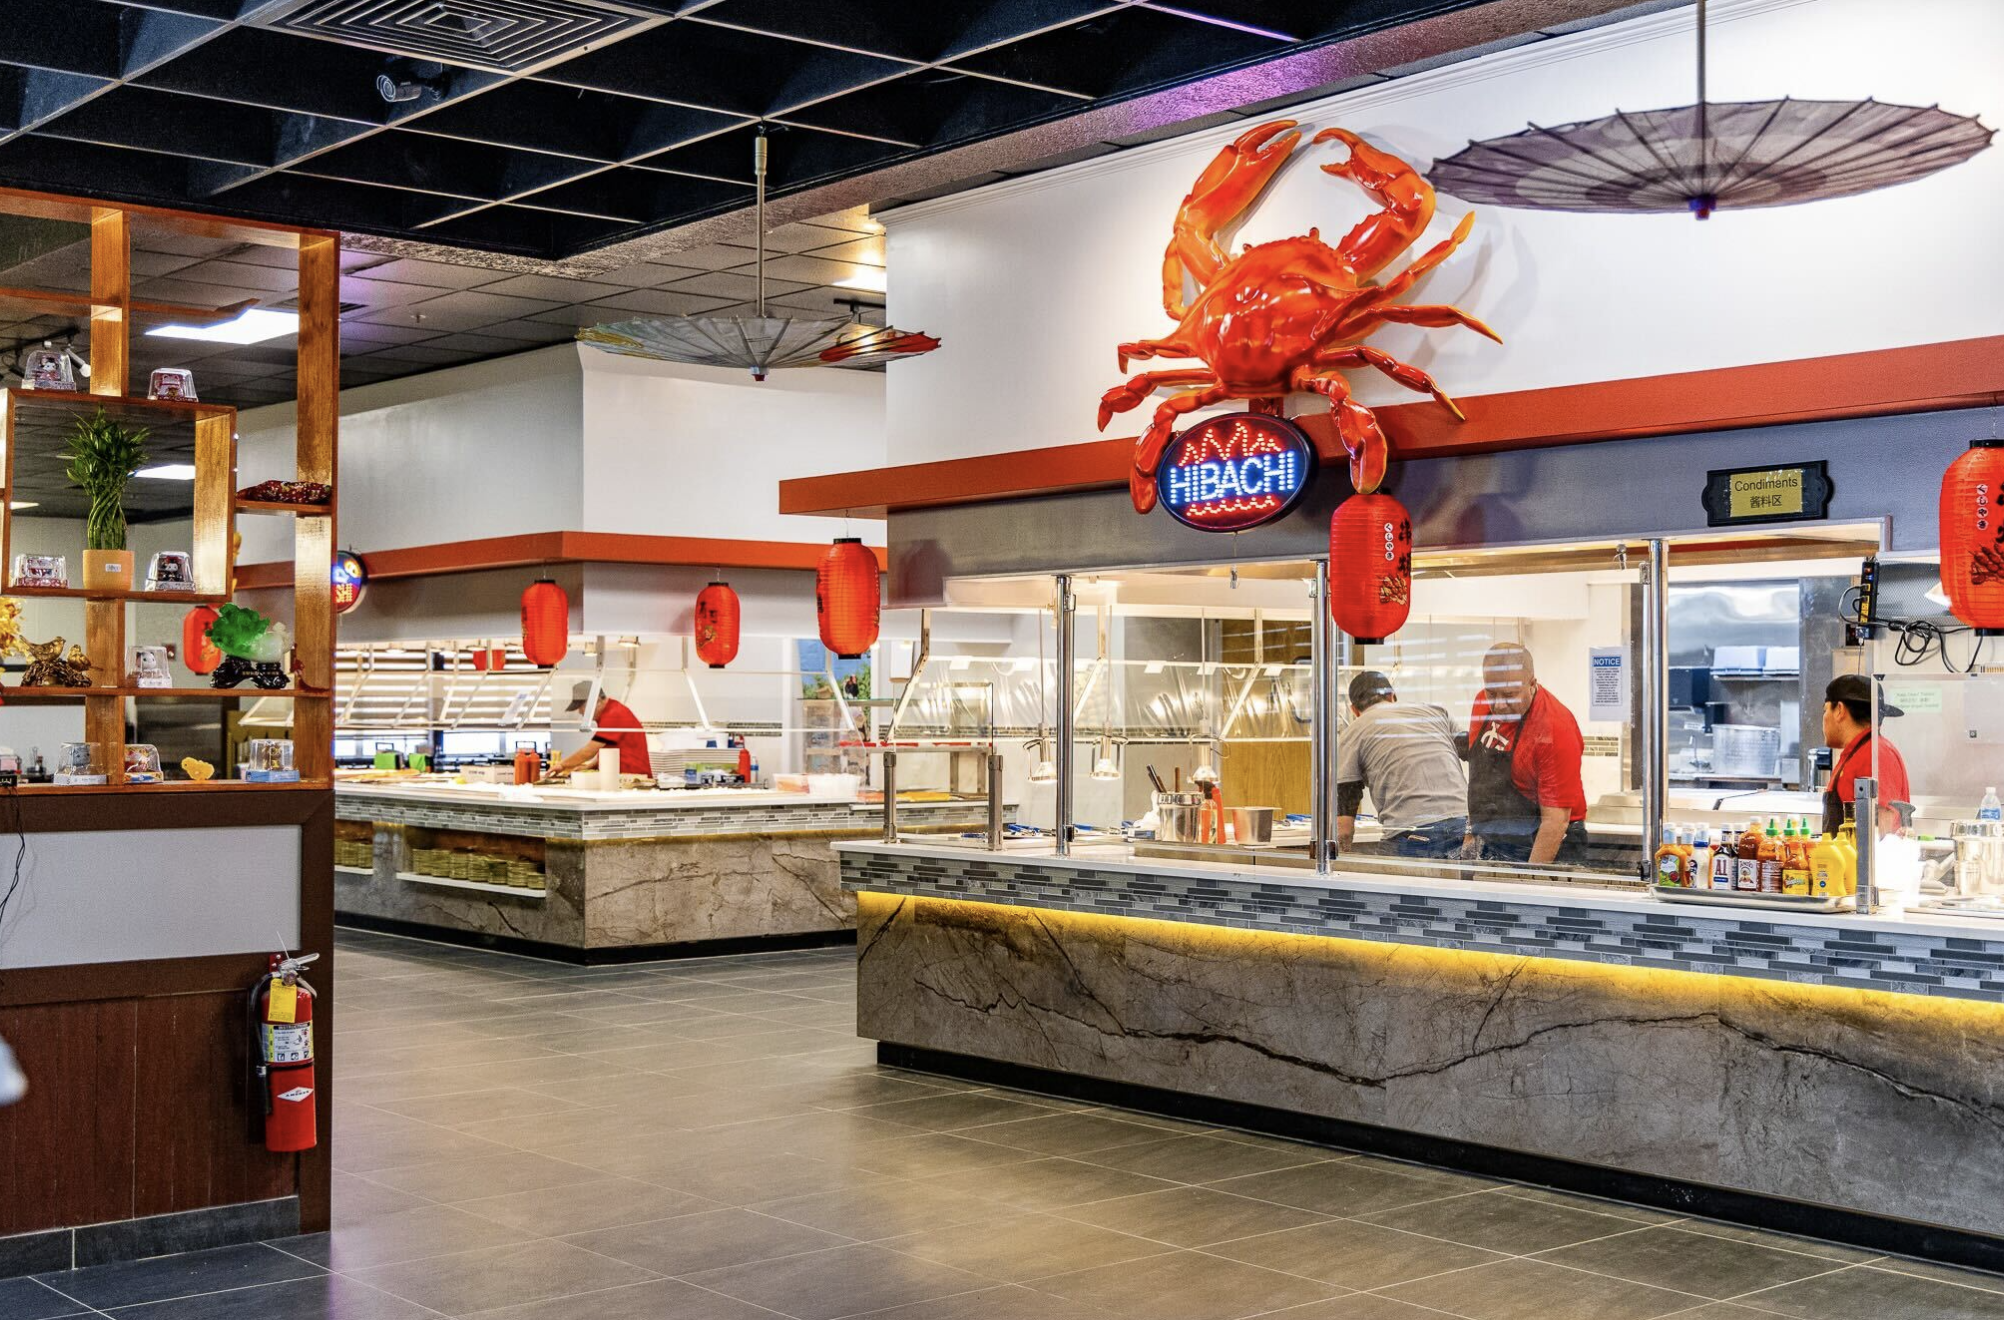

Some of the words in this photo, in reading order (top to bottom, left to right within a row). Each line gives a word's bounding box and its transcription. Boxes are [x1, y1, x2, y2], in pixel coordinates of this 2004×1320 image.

[1169, 450, 1296, 505] HIBACHI
[1734, 477, 1798, 493] Condiments
[1749, 494, 1783, 509] 酱料区
[1594, 658, 1621, 666] NOTICE
